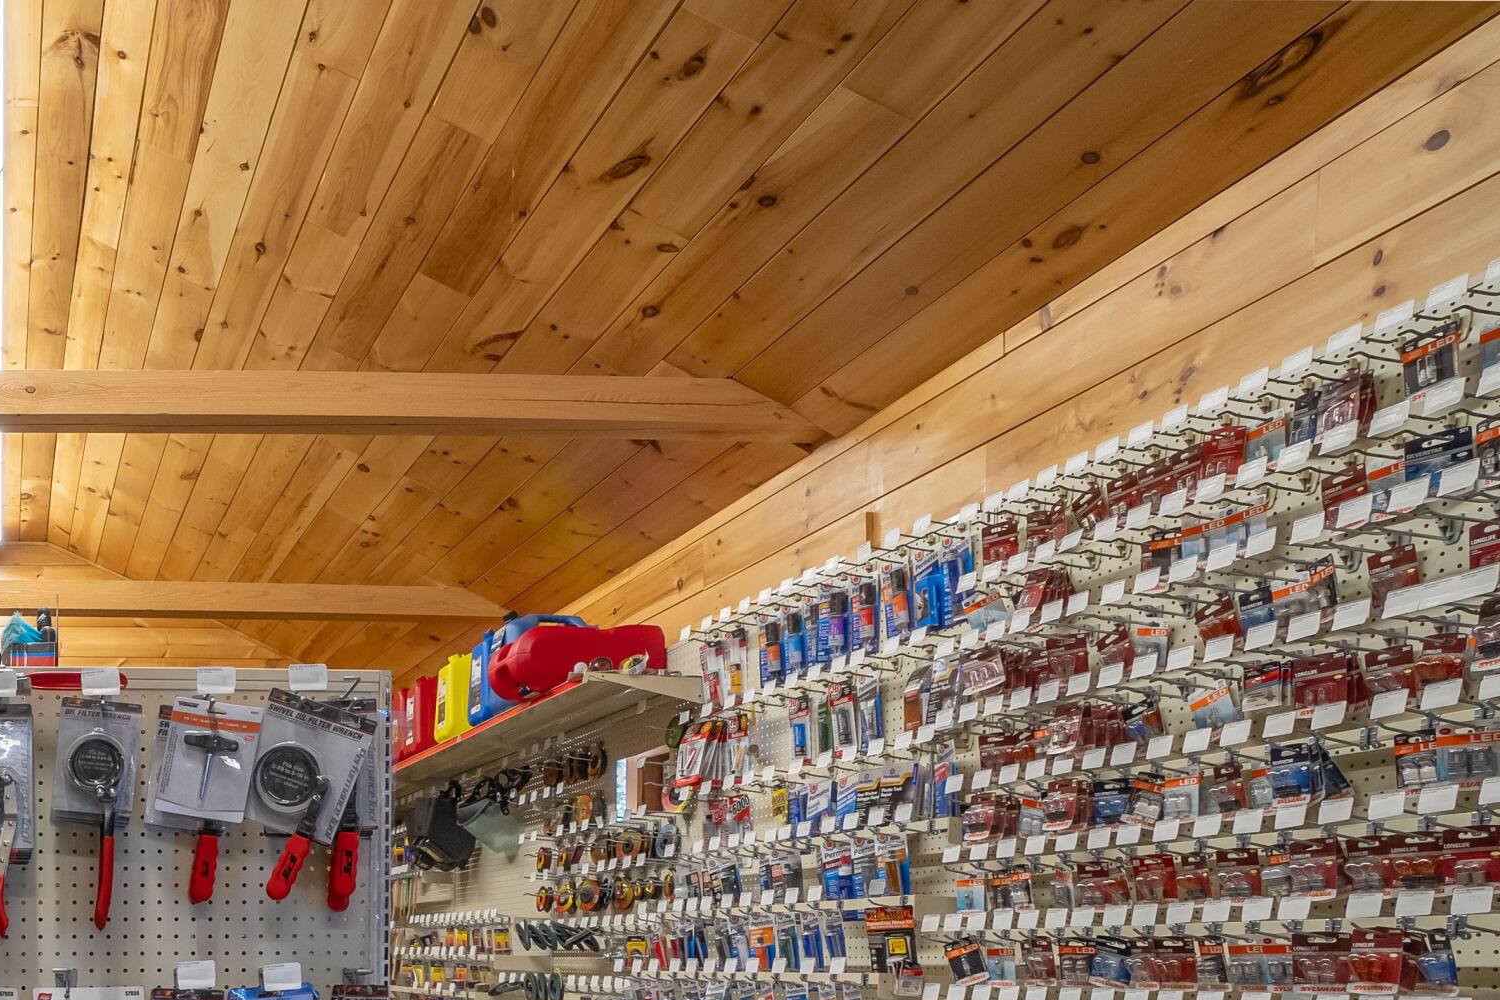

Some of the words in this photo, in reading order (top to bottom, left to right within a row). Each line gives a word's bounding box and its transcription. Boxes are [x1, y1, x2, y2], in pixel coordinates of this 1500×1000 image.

[1427, 335, 1456, 352] LED
[1262, 420, 1284, 434] LED
[1243, 506, 1265, 519] LED
[1202, 520, 1225, 532] LED
[1470, 534, 1497, 546] LONGLIFE
[915, 552, 938, 571] Permatex
[1320, 566, 1335, 579] LED
[1369, 564, 1391, 575] LONGLIFE
[1288, 584, 1309, 594] LED
[1150, 628, 1167, 637] LED
[1294, 669, 1318, 678] LONGLIFE
[1366, 663, 1388, 672] LONGLIFE
[1207, 689, 1227, 703] LED
[77, 709, 100, 718] FILTER
[102, 711, 132, 721] WRENCH
[268, 702, 293, 719] SWIVEL
[295, 711, 307, 723] OIL
[307, 716, 332, 732] FILTER
[332, 724, 364, 741] WRENCH
[808, 784, 830, 801] Permatex
[1443, 841, 1471, 849] LONGLIFE
[962, 942, 979, 954] LED
[1076, 946, 1096, 955] LED
